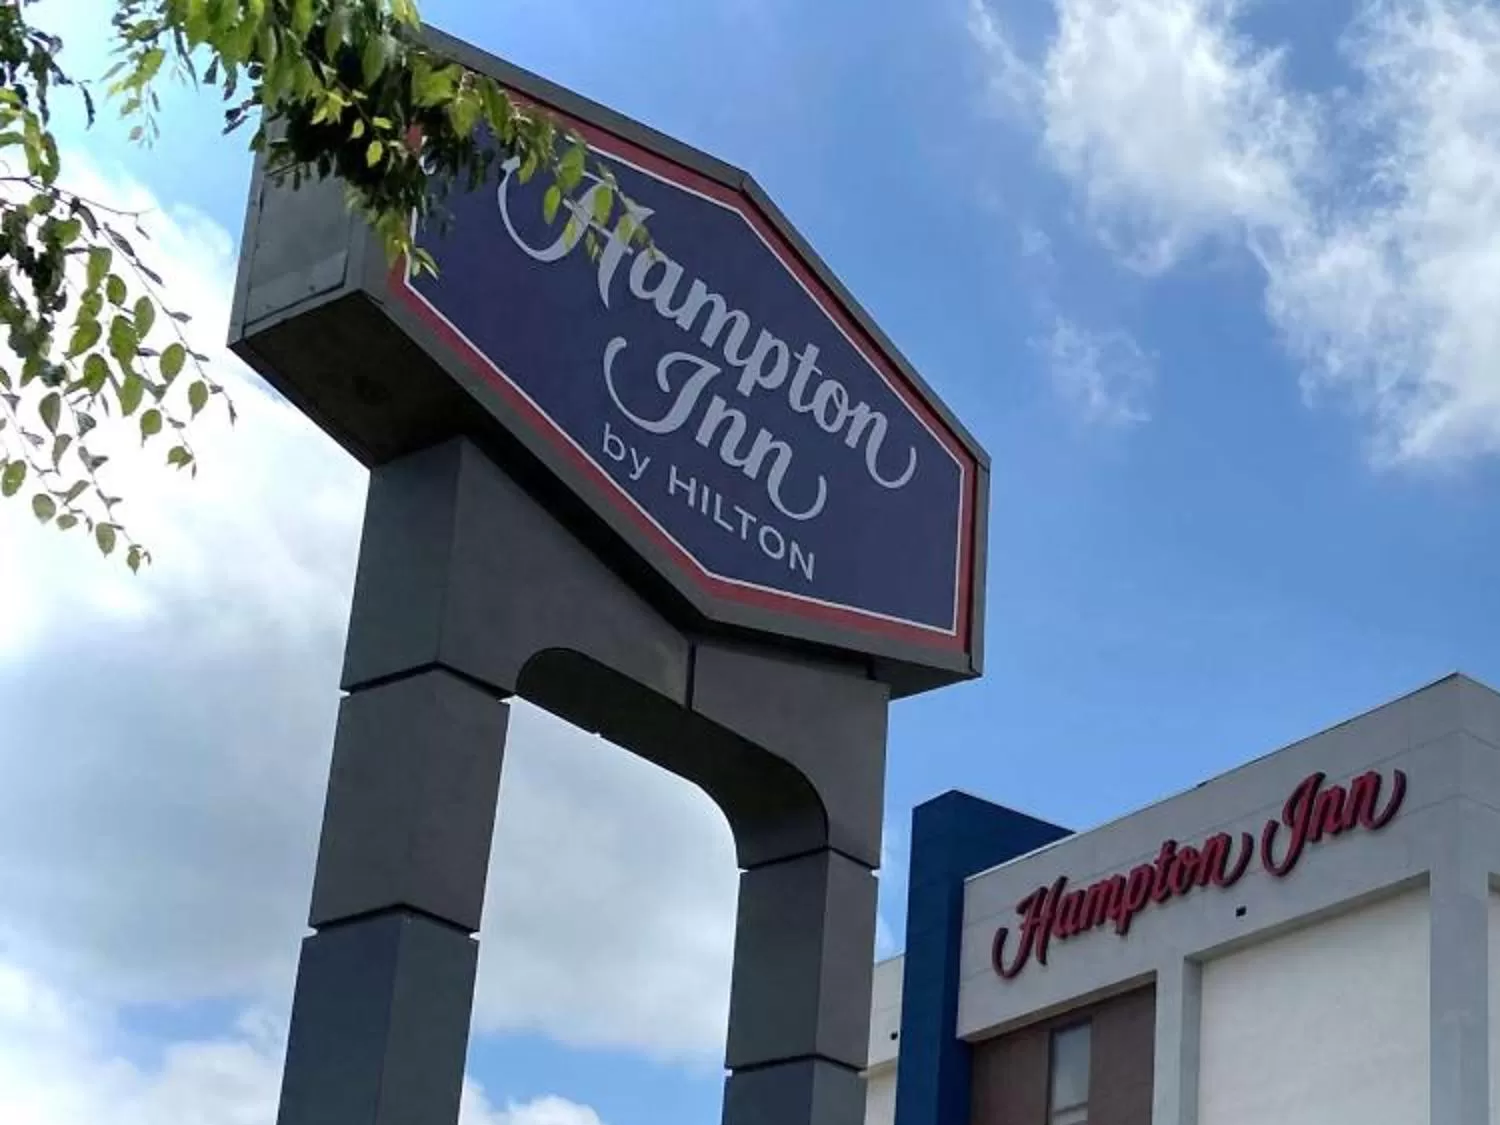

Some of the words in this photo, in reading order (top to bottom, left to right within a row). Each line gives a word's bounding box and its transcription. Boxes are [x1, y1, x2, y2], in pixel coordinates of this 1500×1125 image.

[498, 156, 917, 489] Hampton
[602, 421, 651, 482] by
[668, 463, 816, 582] HILTON
[603, 335, 828, 521] Inn
[991, 830, 1255, 980] Hampton
[1260, 767, 1408, 878] Inn
